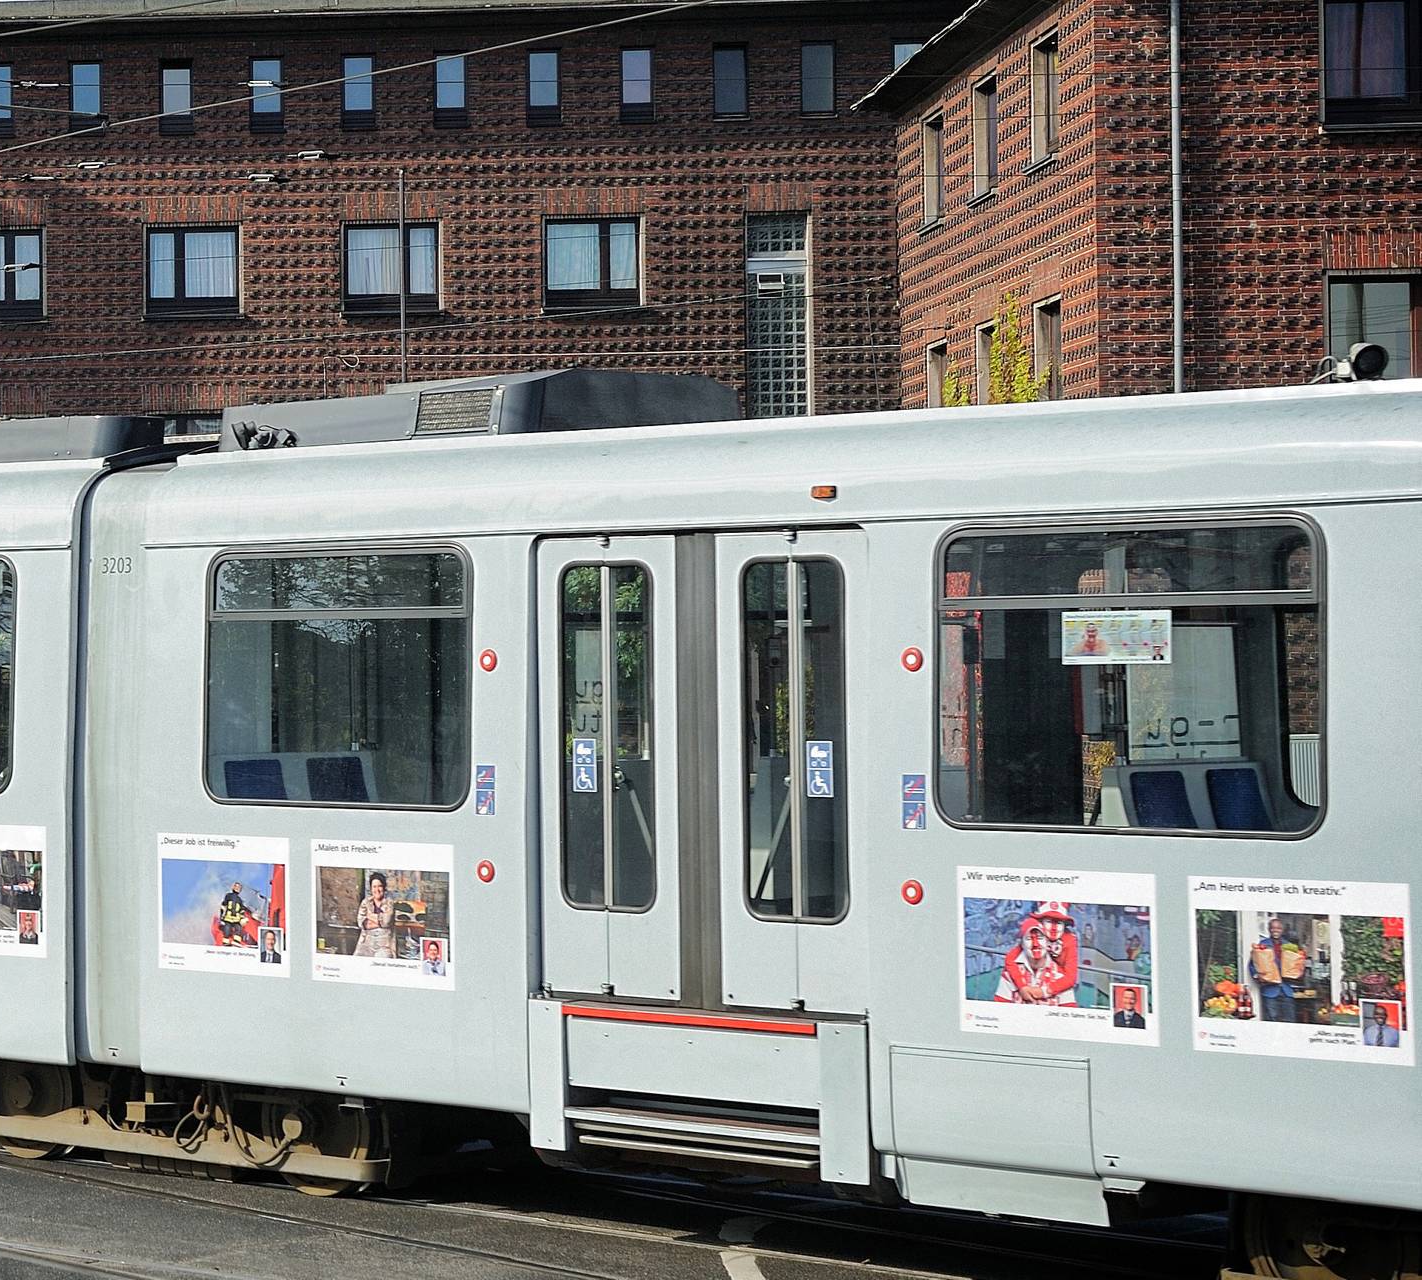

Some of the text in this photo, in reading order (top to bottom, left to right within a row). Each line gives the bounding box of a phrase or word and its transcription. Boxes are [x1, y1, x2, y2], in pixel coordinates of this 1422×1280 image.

[101, 557, 132, 574] 3203
[986, 873, 1022, 883] werden
[1219, 882, 1244, 892] Herd
[1248, 884, 1280, 894] werde
[1283, 884, 1299, 894] ich
